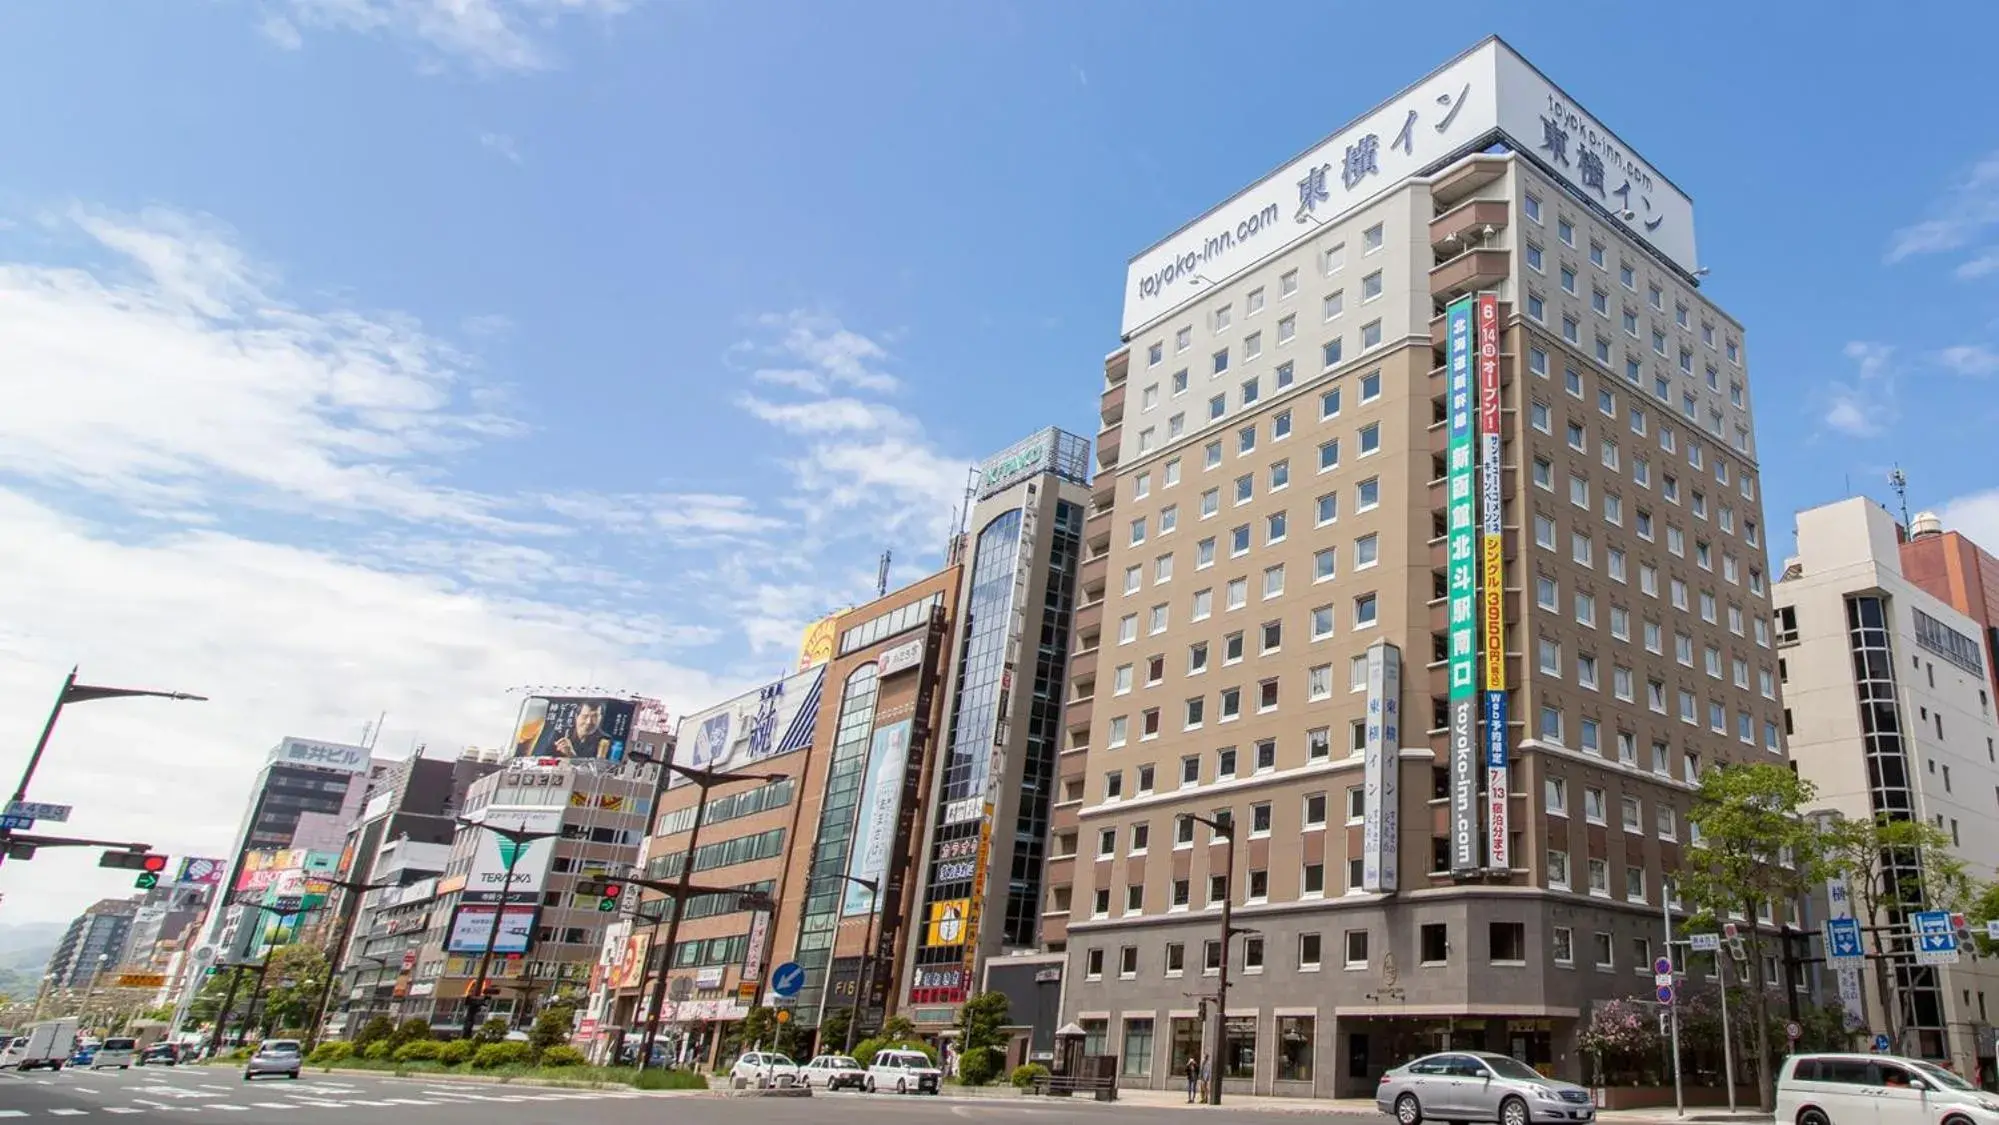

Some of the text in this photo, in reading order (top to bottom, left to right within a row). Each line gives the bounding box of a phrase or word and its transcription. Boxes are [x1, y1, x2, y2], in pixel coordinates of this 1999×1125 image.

[1294, 82, 1470, 219] 東横イン
[1538, 114, 1663, 232] 東横イン
[1546, 92, 1653, 192] toyoko-inn.com
[1139, 202, 1278, 299] toyoko-inn.com
[1452, 318, 1467, 429] 北海道新幹線
[1452, 443, 1472, 688] 新函館北斗駅南口
[1385, 699, 1397, 797] 東横イン
[1456, 702, 1471, 863] toyoko-inn.com
